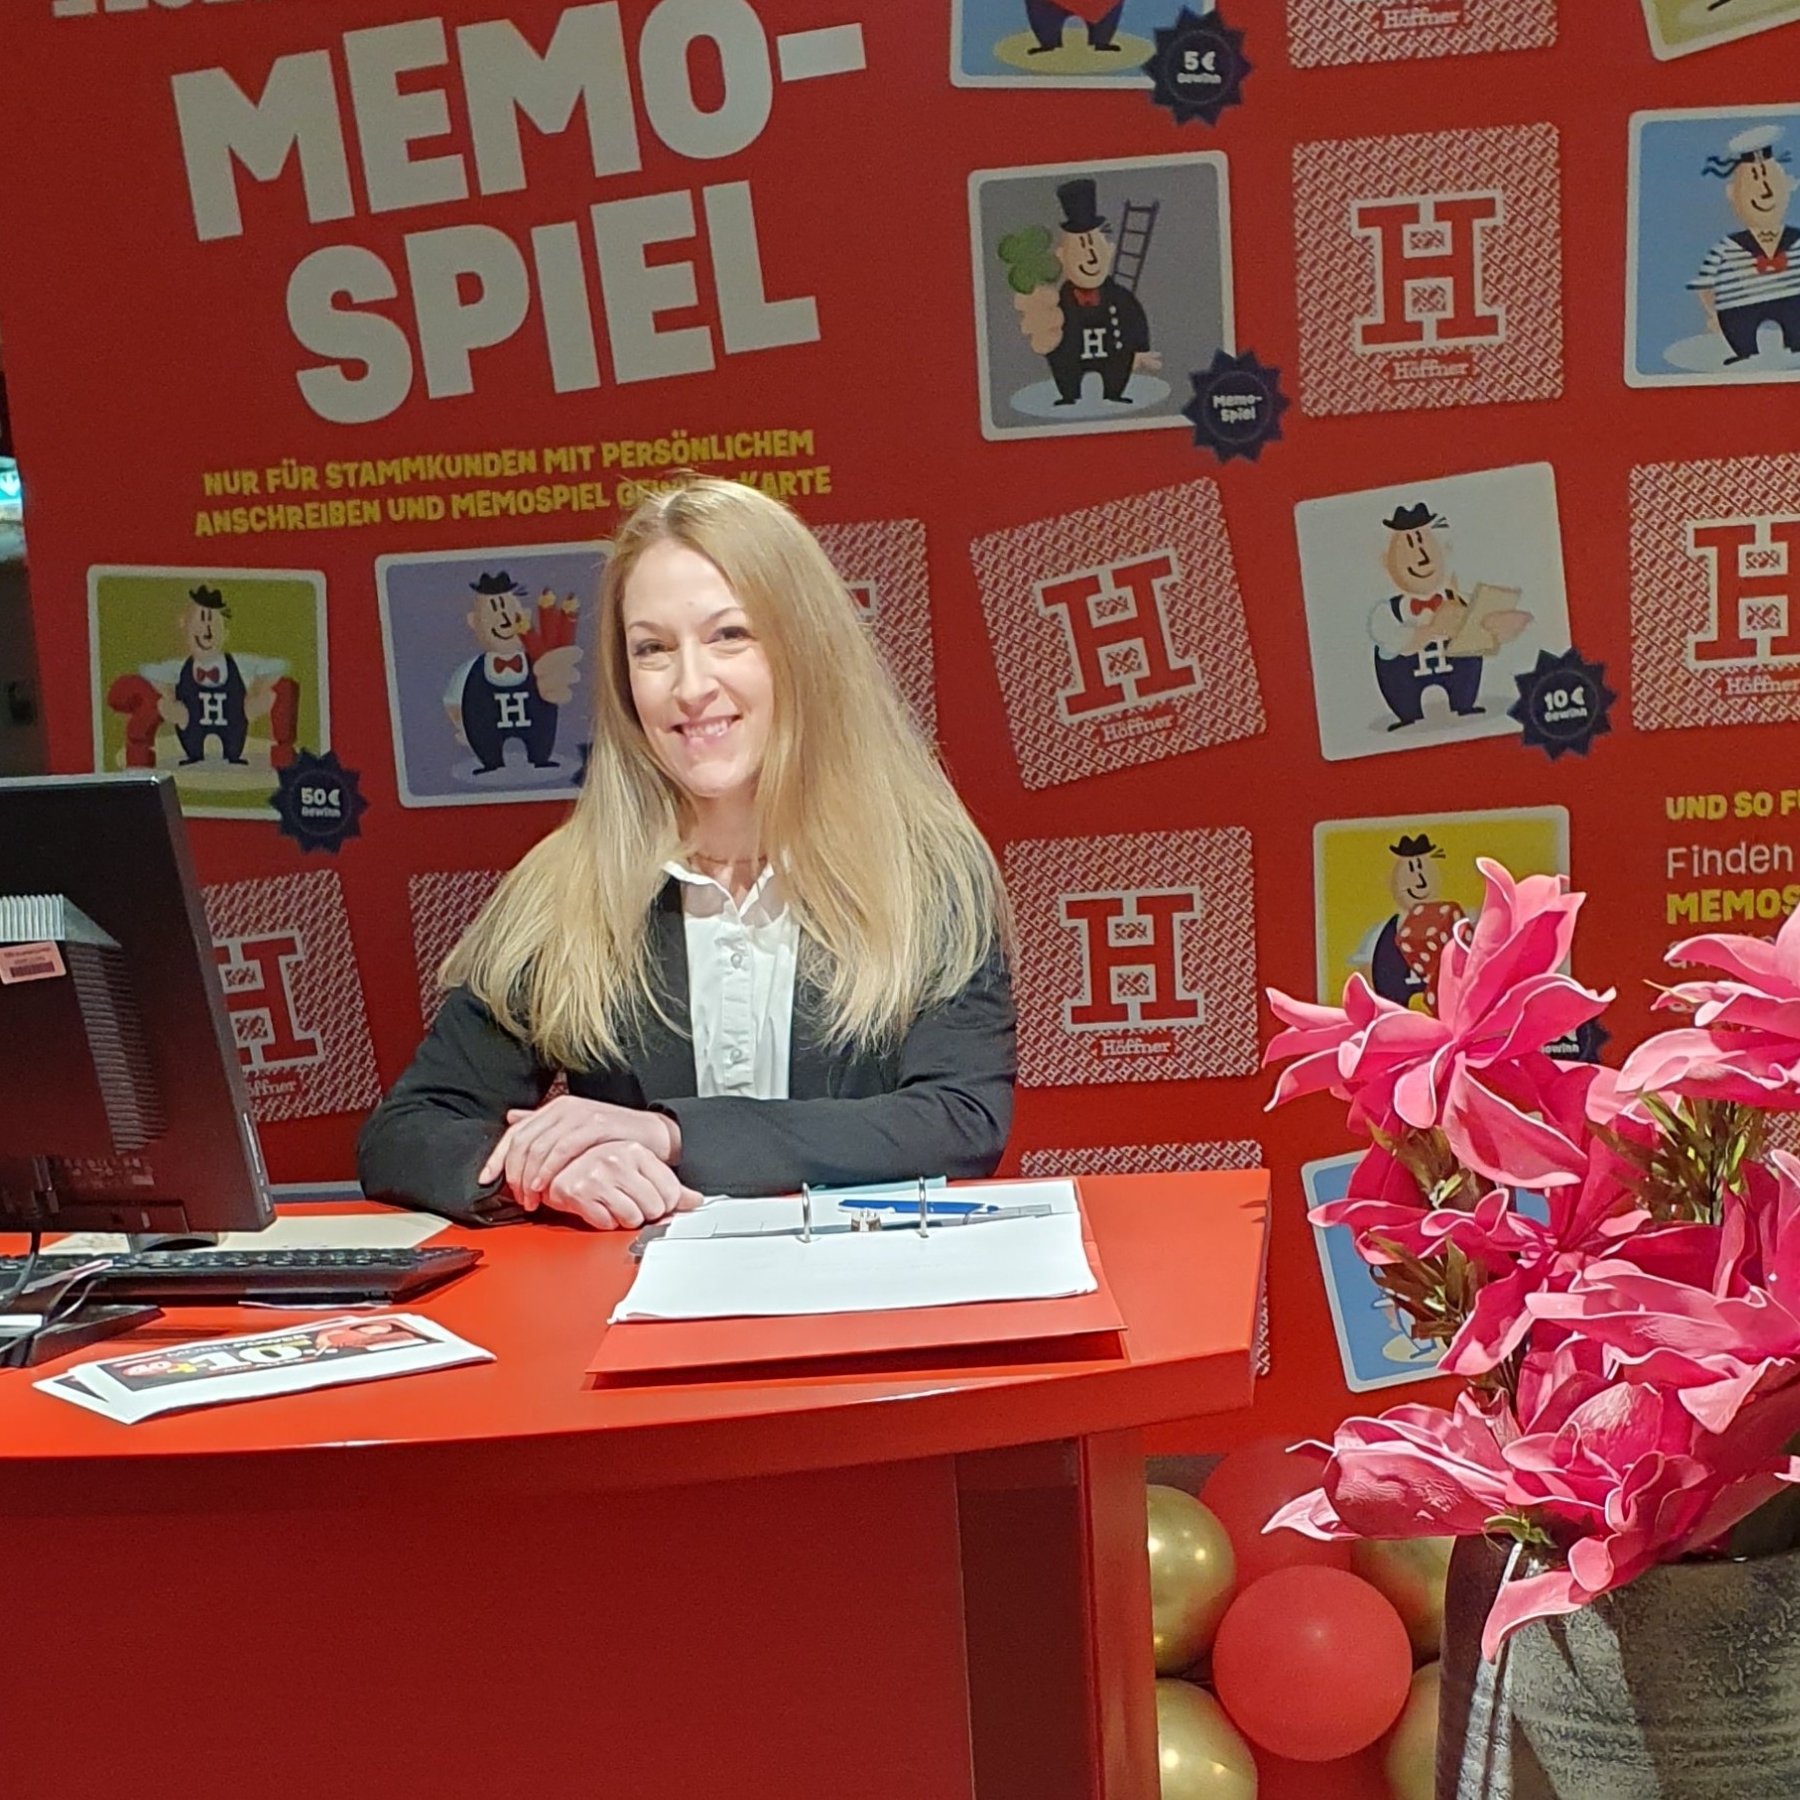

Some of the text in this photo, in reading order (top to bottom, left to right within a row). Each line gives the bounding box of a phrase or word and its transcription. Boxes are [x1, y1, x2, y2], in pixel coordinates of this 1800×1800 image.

[171, 0, 867, 241] MEMO-
[1350, 190, 1507, 354] H
[286, 181, 821, 424] SPIEL
[1081, 328, 1108, 359] H
[203, 429, 815, 496] NUR FÜR STAMMKUNDEN MIT PERSÖNLICHEM
[195, 498, 381, 537] ANSCHREIBEN
[387, 494, 446, 521] UND
[451, 482, 611, 520] MEMOSPIEL
[1033, 547, 1204, 724] H
[198, 691, 228, 726] H
[493, 691, 532, 728] H
[301, 786, 341, 807] 50€
[1666, 794, 1728, 820] UND
[1734, 790, 1773, 818] SO
[1667, 841, 1793, 879] Finden
[1059, 886, 1205, 1032] H
